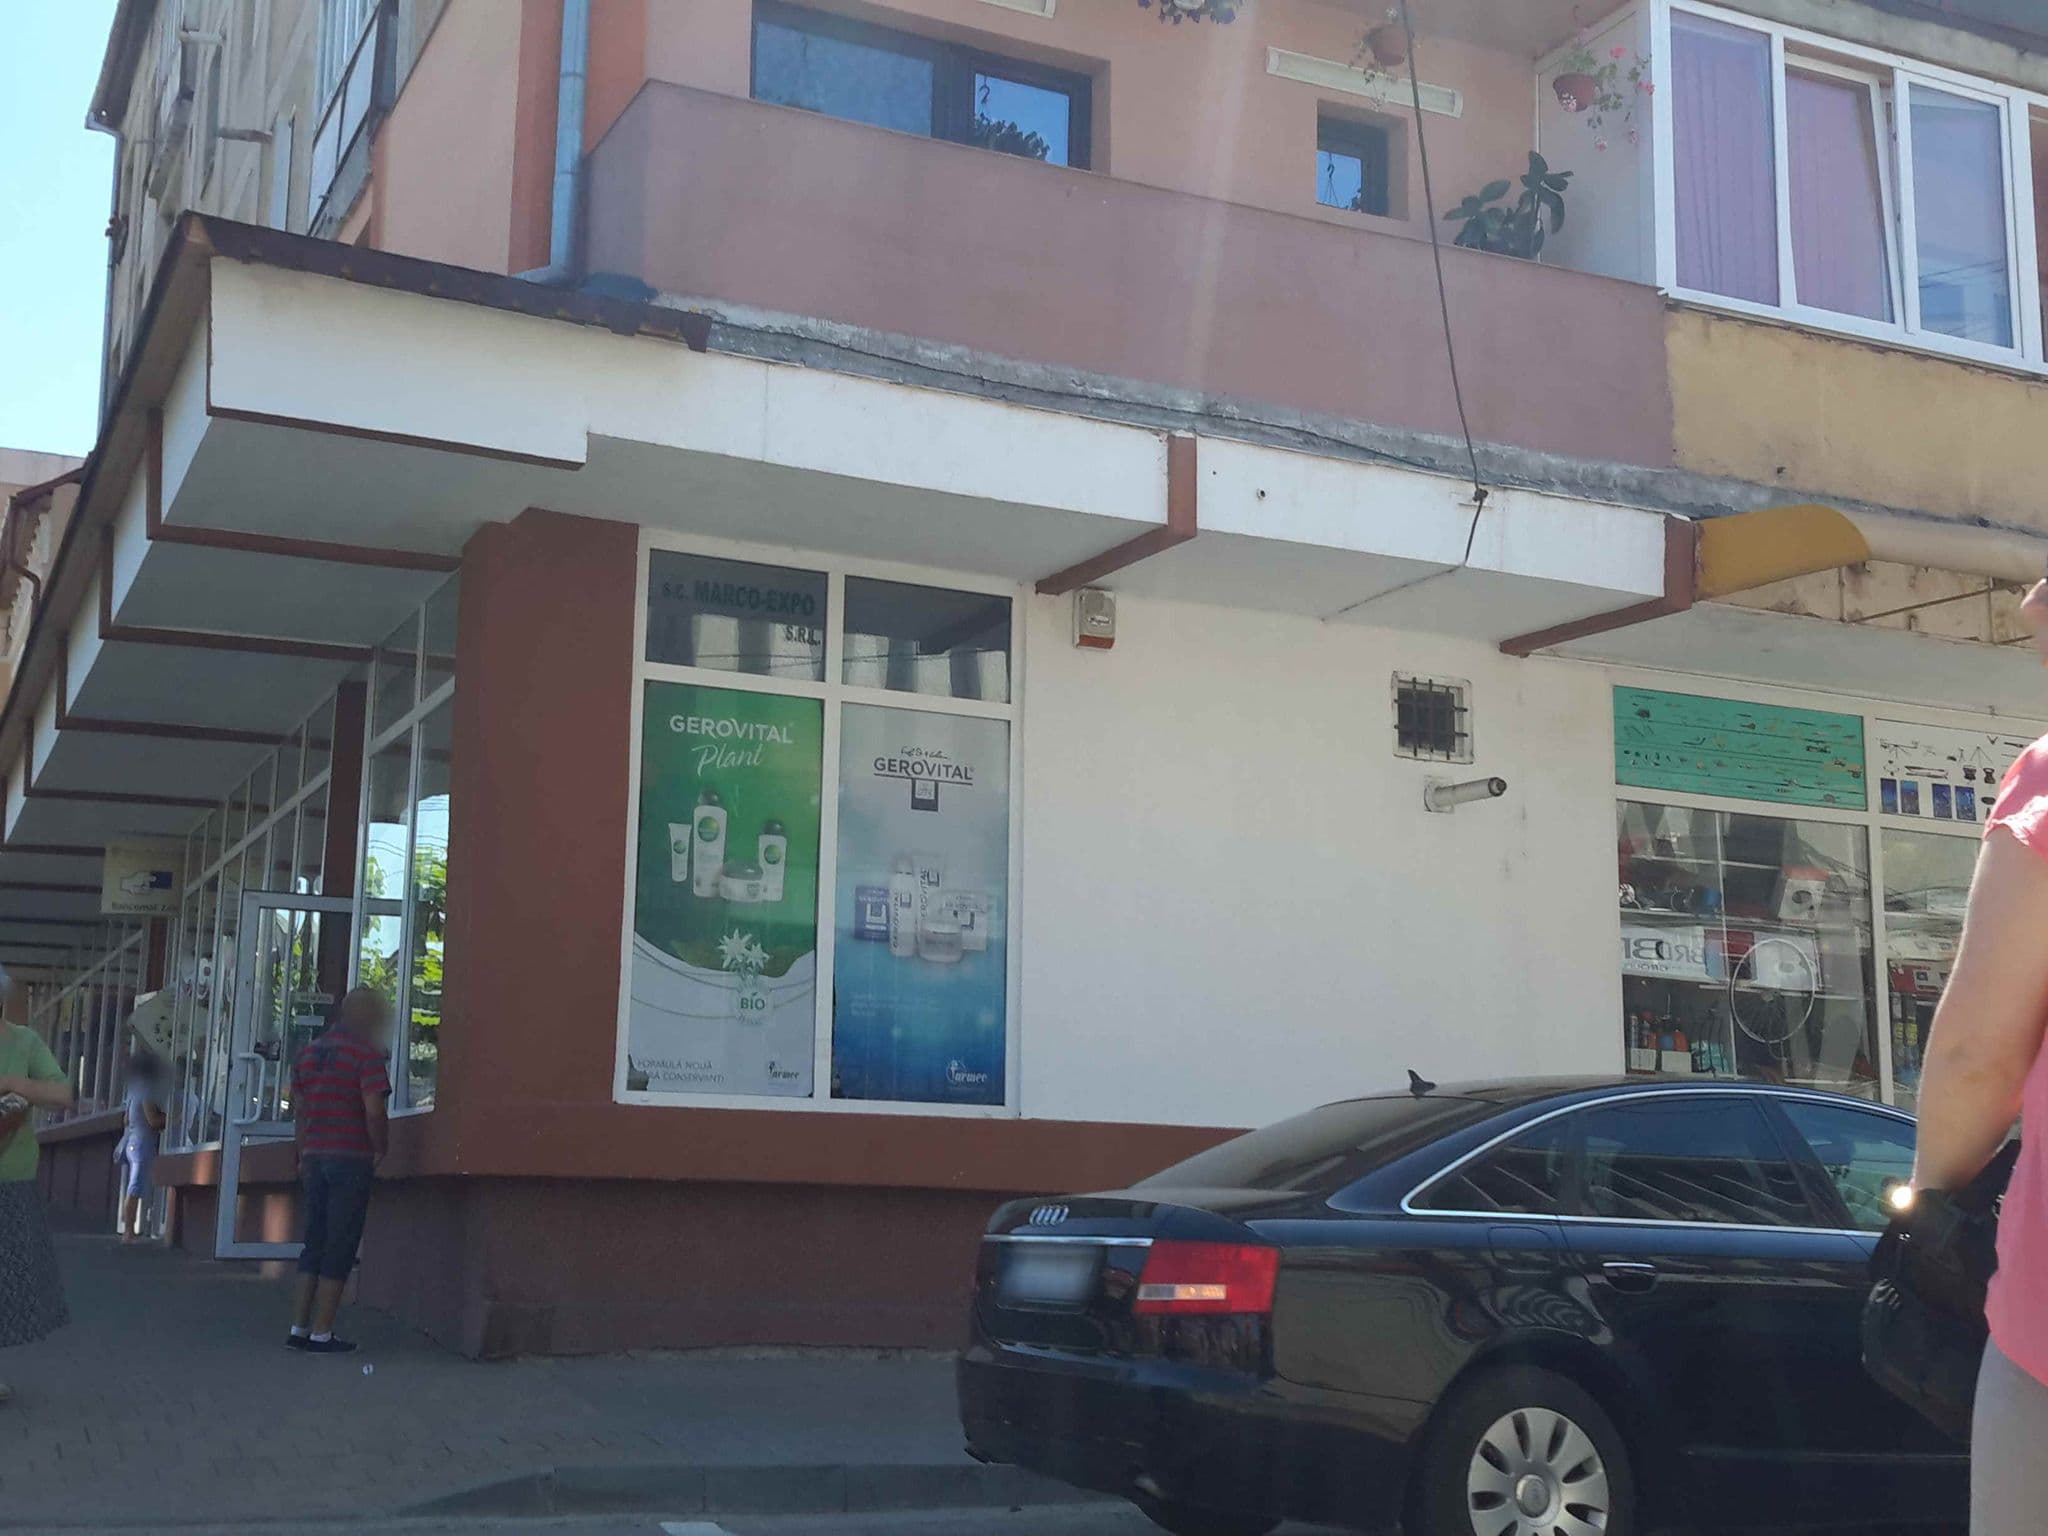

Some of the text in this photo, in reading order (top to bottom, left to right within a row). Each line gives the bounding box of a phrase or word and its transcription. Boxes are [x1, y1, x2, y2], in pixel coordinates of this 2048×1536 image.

[694, 579, 816, 616] MARCO-EXPO
[670, 714, 793, 744] GEROVITAL
[691, 743, 764, 777] Plant
[873, 757, 974, 781] GEROVITAL
[740, 996, 766, 1011] BIO
